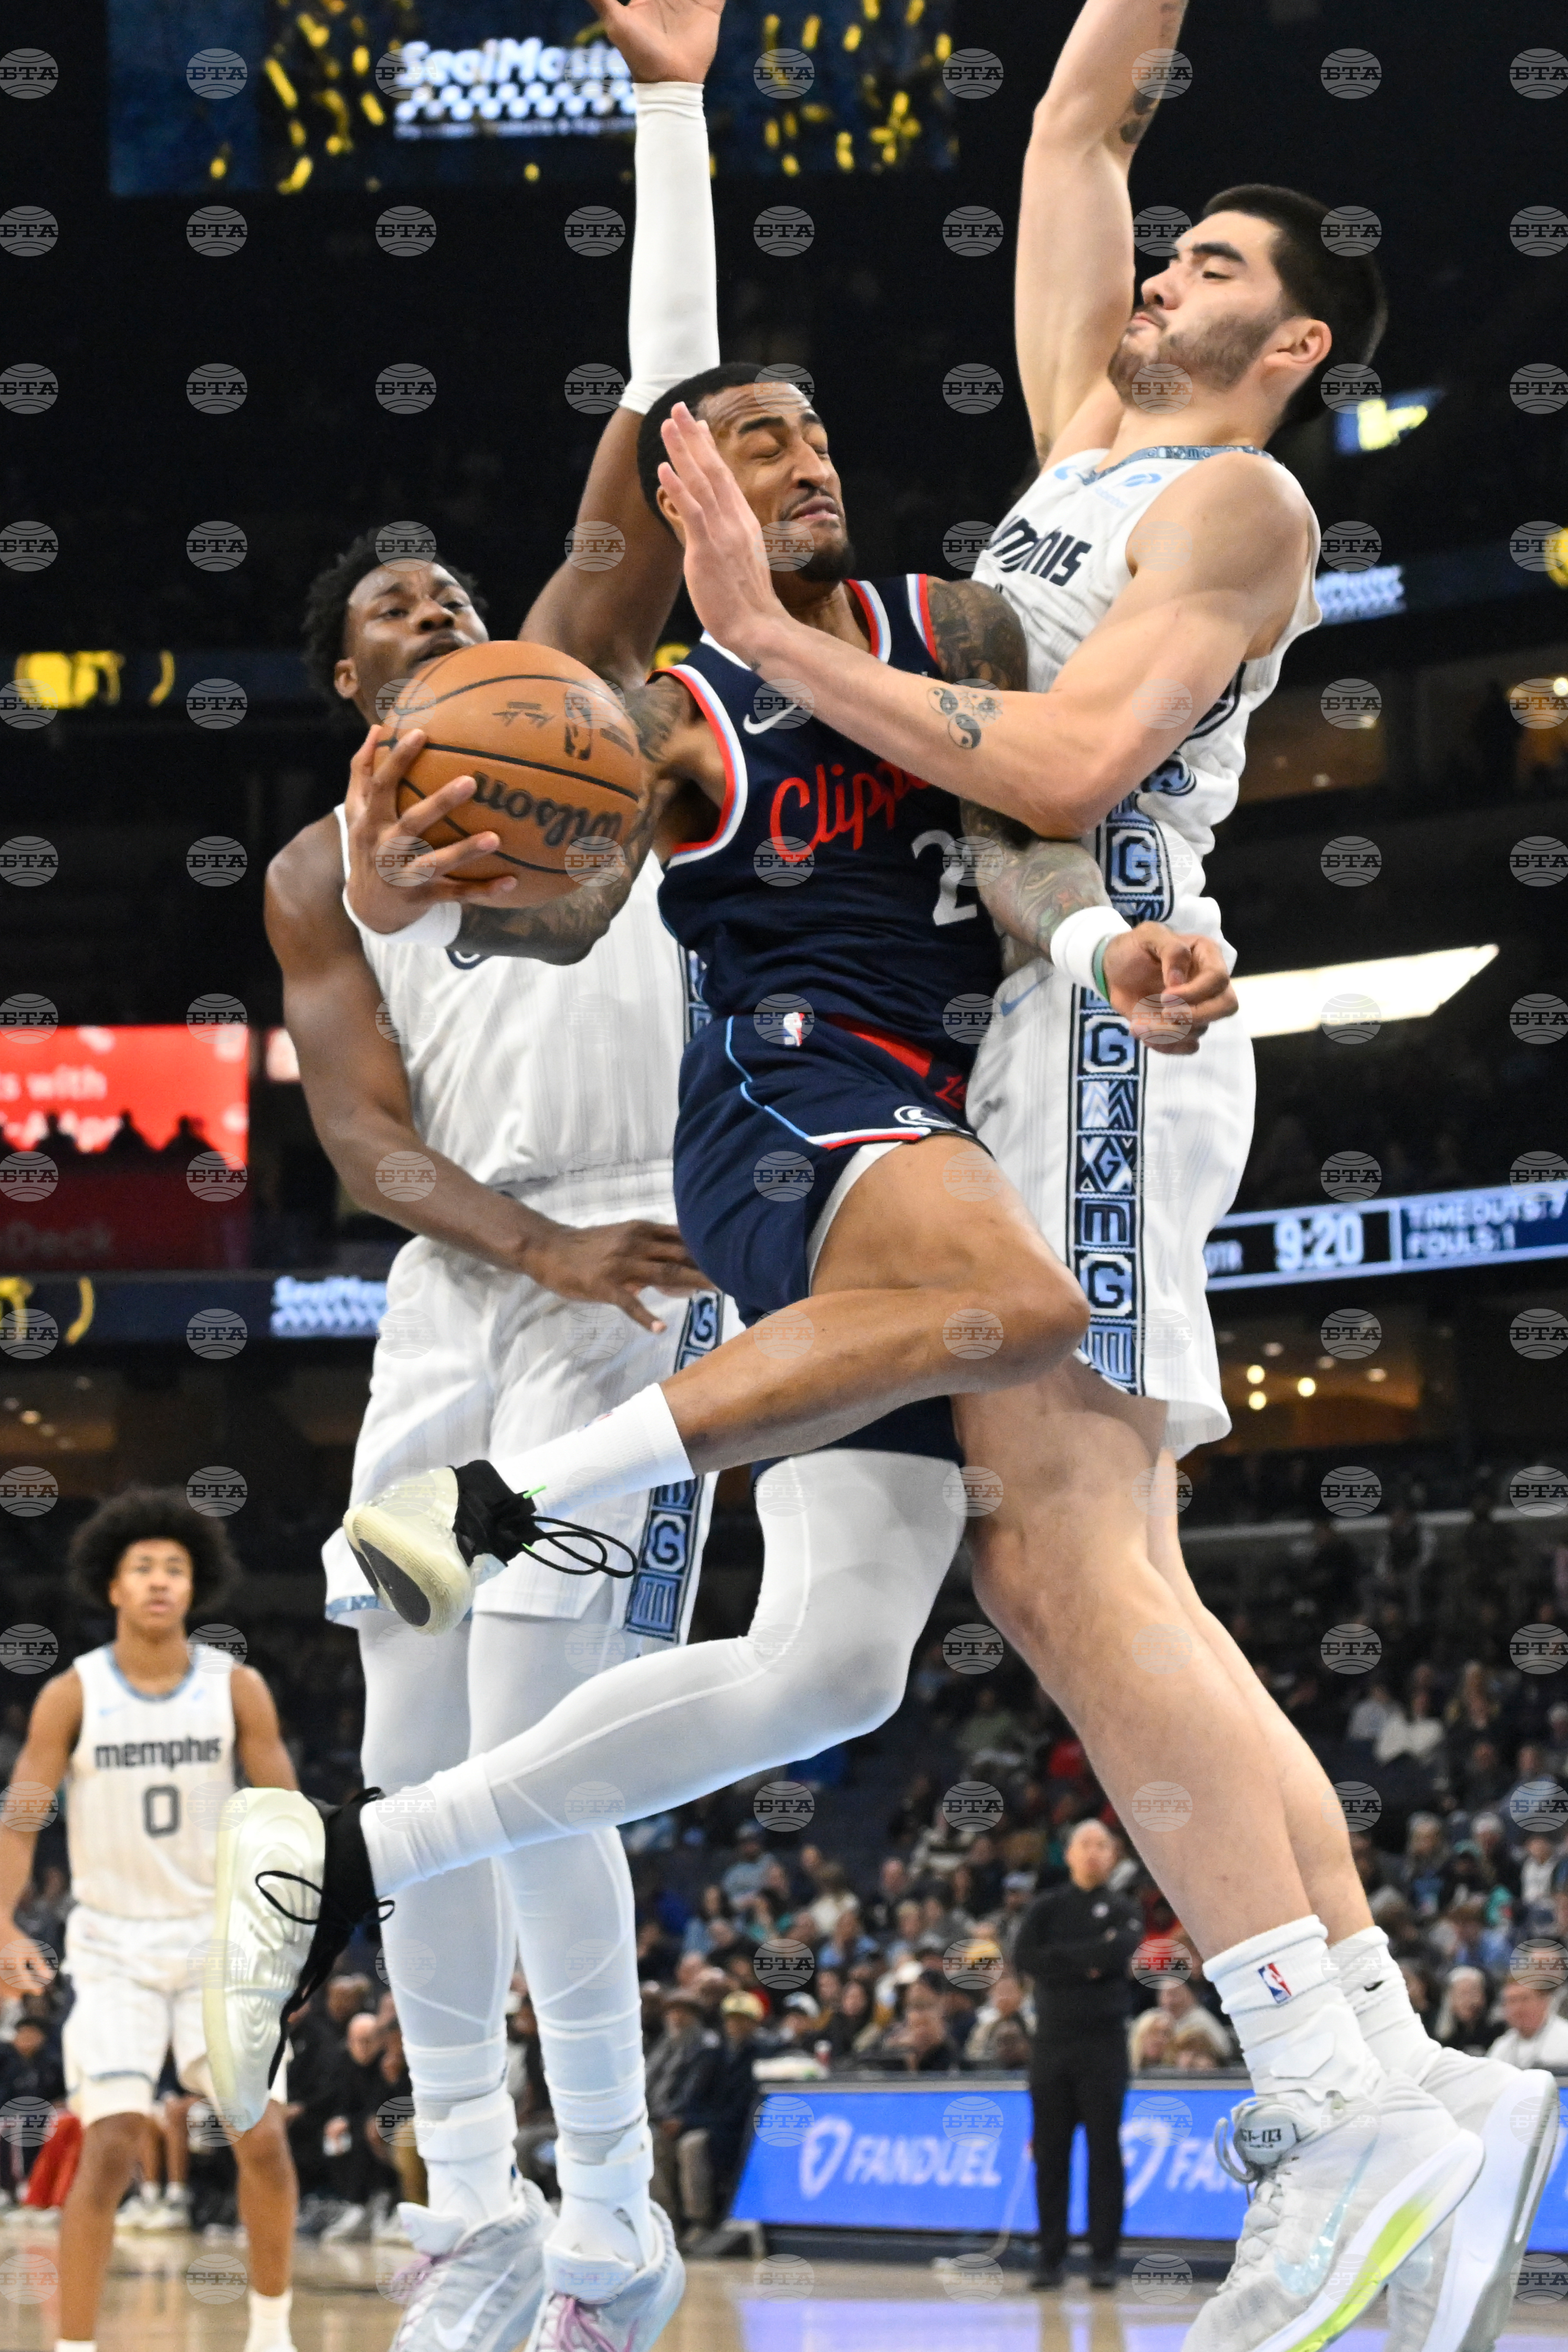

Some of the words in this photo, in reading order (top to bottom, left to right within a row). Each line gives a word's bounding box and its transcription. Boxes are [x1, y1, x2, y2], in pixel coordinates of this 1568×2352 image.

[770, 760, 929, 862] Clipp
[1274, 1213, 1365, 1271] 9:20
[141, 1783, 182, 1838] 0
[843, 2133, 1002, 2187] FANDUEL
